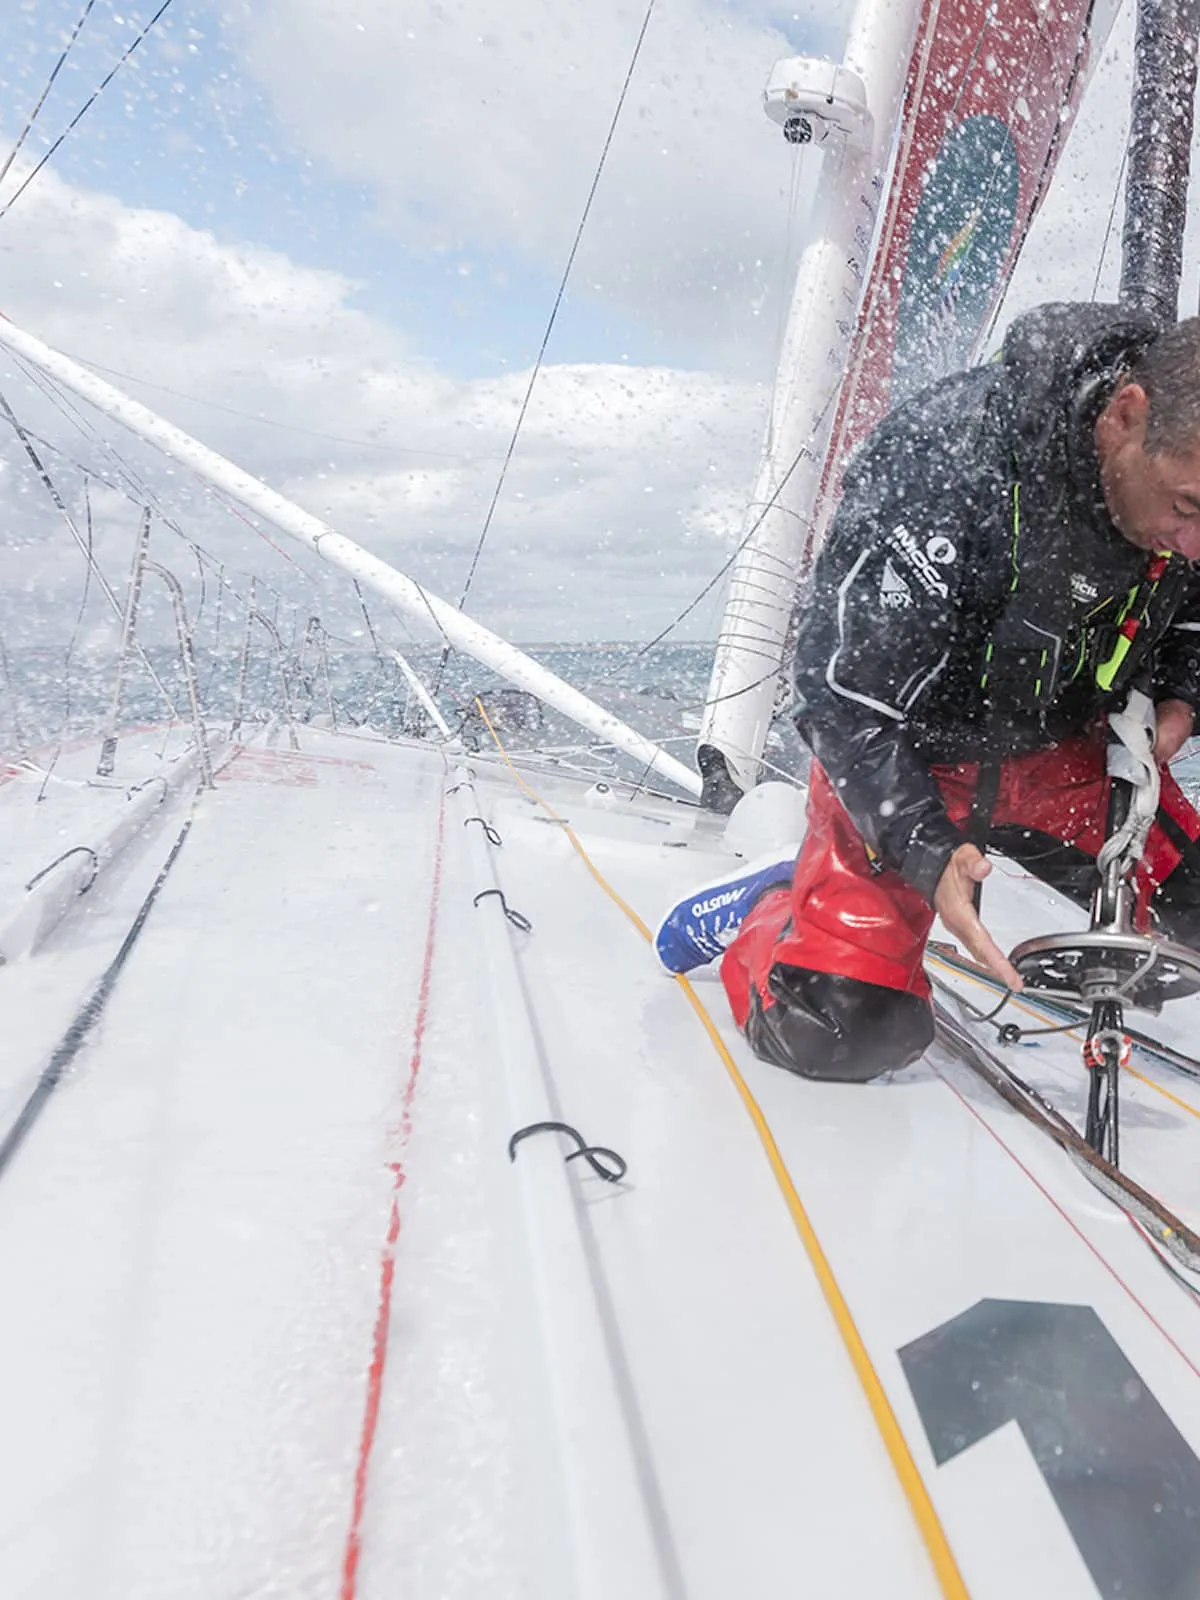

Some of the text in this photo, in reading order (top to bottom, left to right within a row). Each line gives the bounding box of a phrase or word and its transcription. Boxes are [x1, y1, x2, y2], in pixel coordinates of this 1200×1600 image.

[892, 523, 949, 599] IMOCA
[879, 591, 914, 609] MPX
[691, 886, 747, 918] MUSTO
